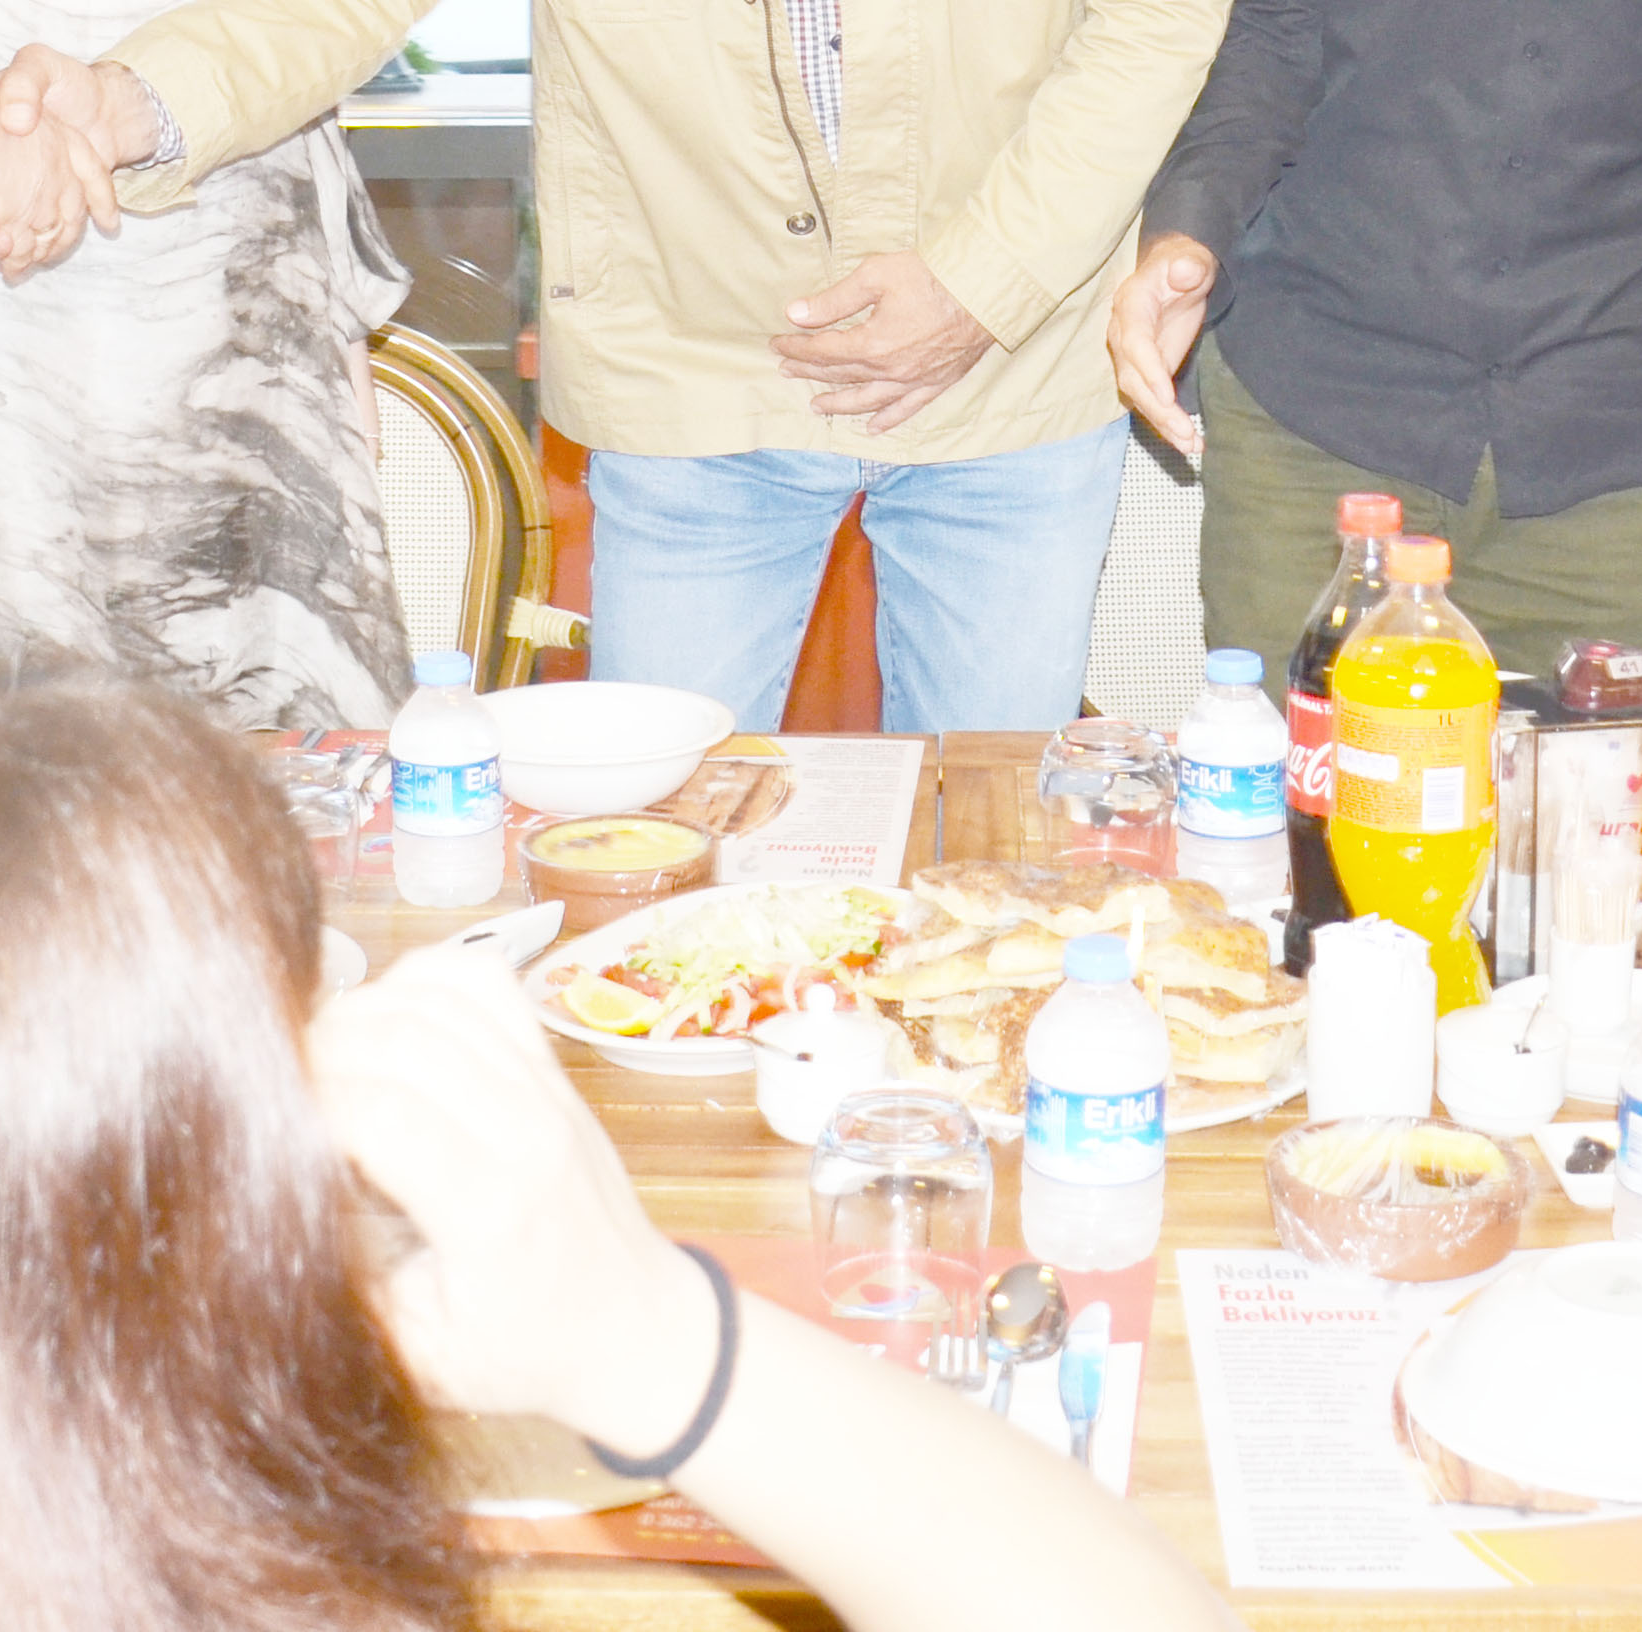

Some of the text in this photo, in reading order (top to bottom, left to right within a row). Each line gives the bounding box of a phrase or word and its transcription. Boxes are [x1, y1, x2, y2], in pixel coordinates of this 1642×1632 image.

[1181, 762, 1231, 792] Erikli
[1084, 1091, 1156, 1129] Erikli
[1213, 1264, 1309, 1280] Neden
[1217, 1284, 1295, 1301] Fazla
[1221, 1306, 1381, 1324] Bekliyoruz
